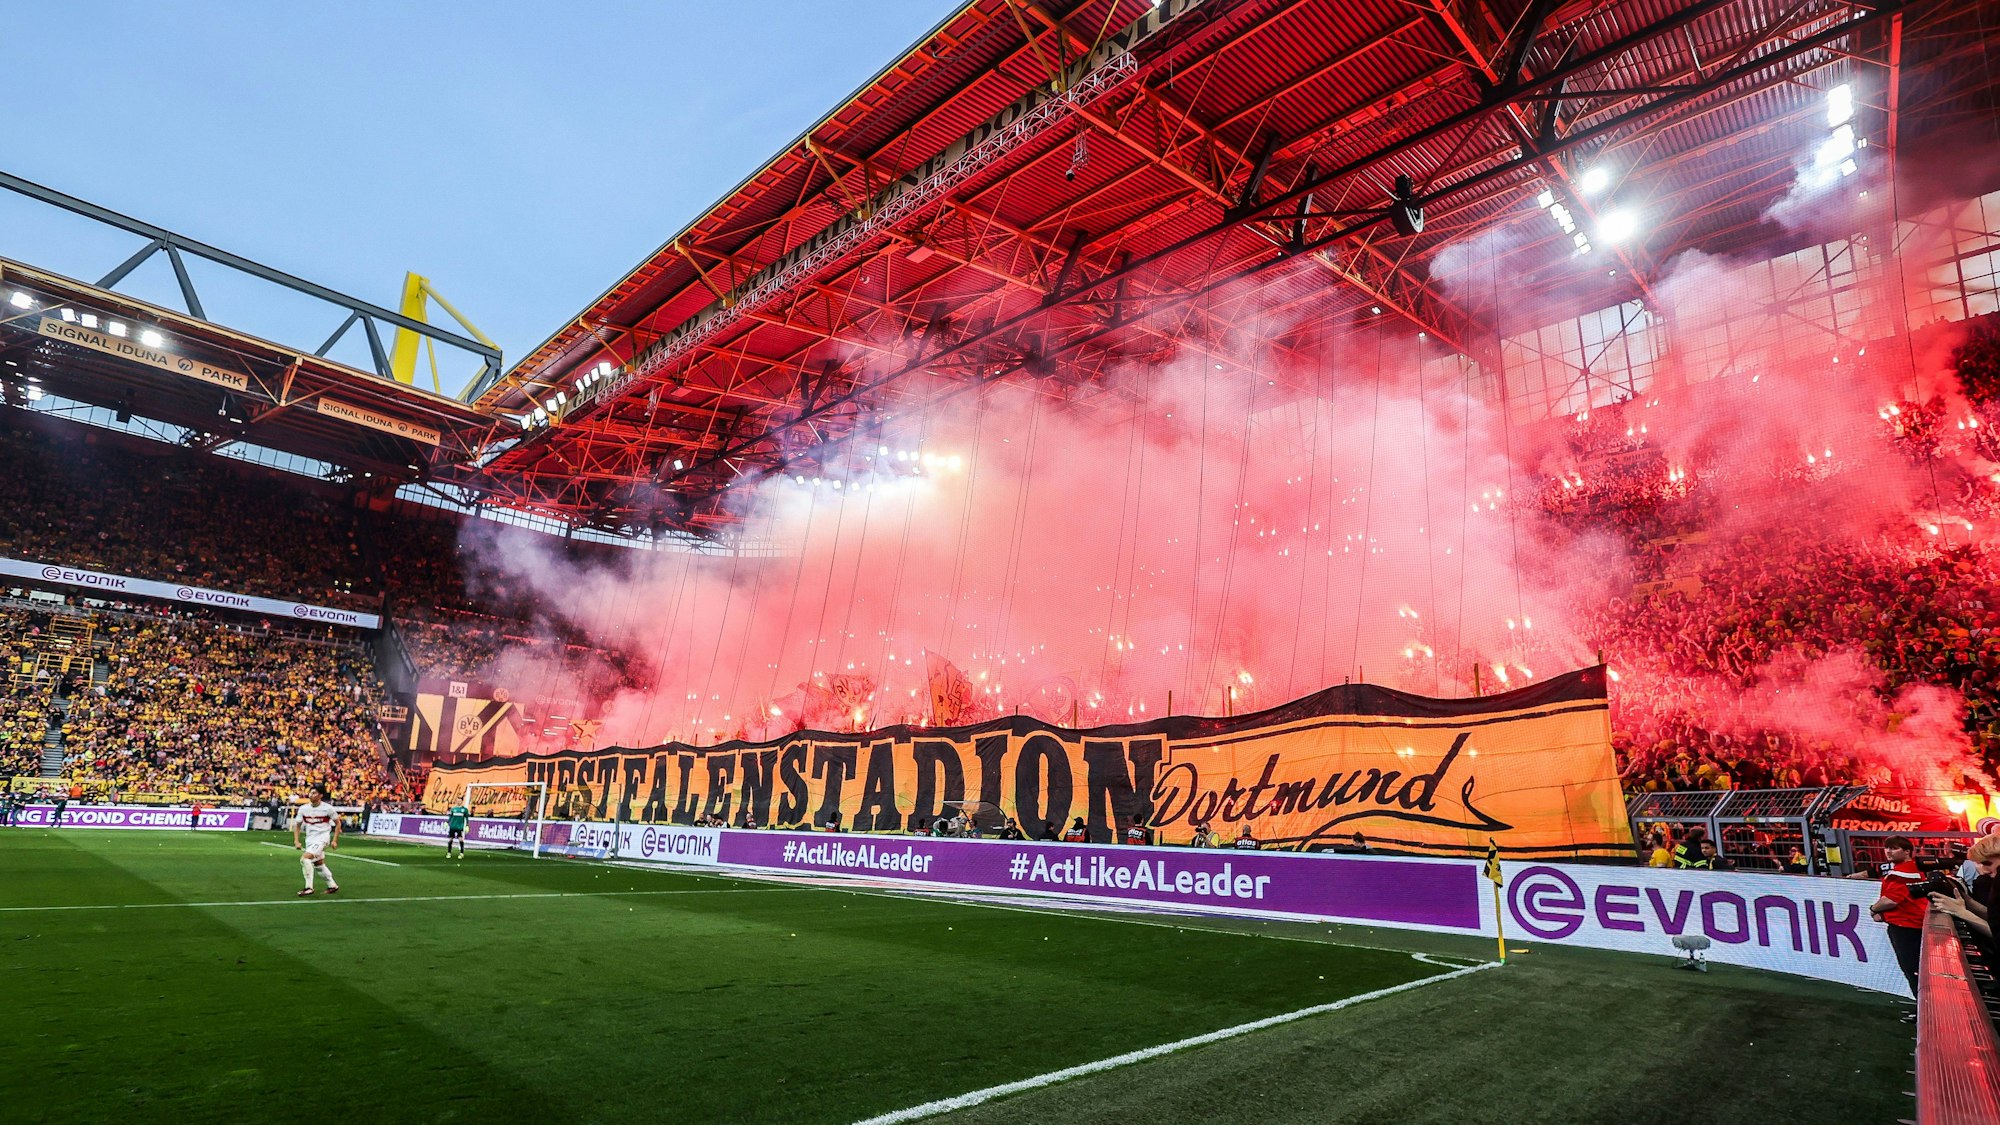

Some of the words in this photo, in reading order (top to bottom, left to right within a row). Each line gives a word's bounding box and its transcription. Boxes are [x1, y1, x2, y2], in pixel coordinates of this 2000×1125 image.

[45, 322, 111, 351] SIGNAL
[115, 341, 168, 367] IDUNA
[201, 367, 244, 387] PARK
[322, 402, 361, 422] SIGNAL
[362, 412, 393, 429] IDUNA
[411, 426, 438, 442] PARK
[62, 571, 126, 589] EVONIK
[192, 591, 250, 608] EVONIK
[306, 608, 357, 623] EVONIK
[452, 685, 465, 694] 1&1
[460, 717, 480, 731] BVB
[527, 735, 1164, 844] WESTFALENSTADION
[1150, 732, 1472, 827] Dortmund
[46, 811, 125, 824] BEYOND
[128, 811, 229, 827] CHEMISTRY
[655, 833, 713, 857] EVONIK
[1236, 839, 1258, 847] atlas
[783, 840, 933, 874] #ActLikeALeader
[1009, 852, 1271, 899] #ActLikeALeader
[1594, 884, 1868, 963] EVONIK
